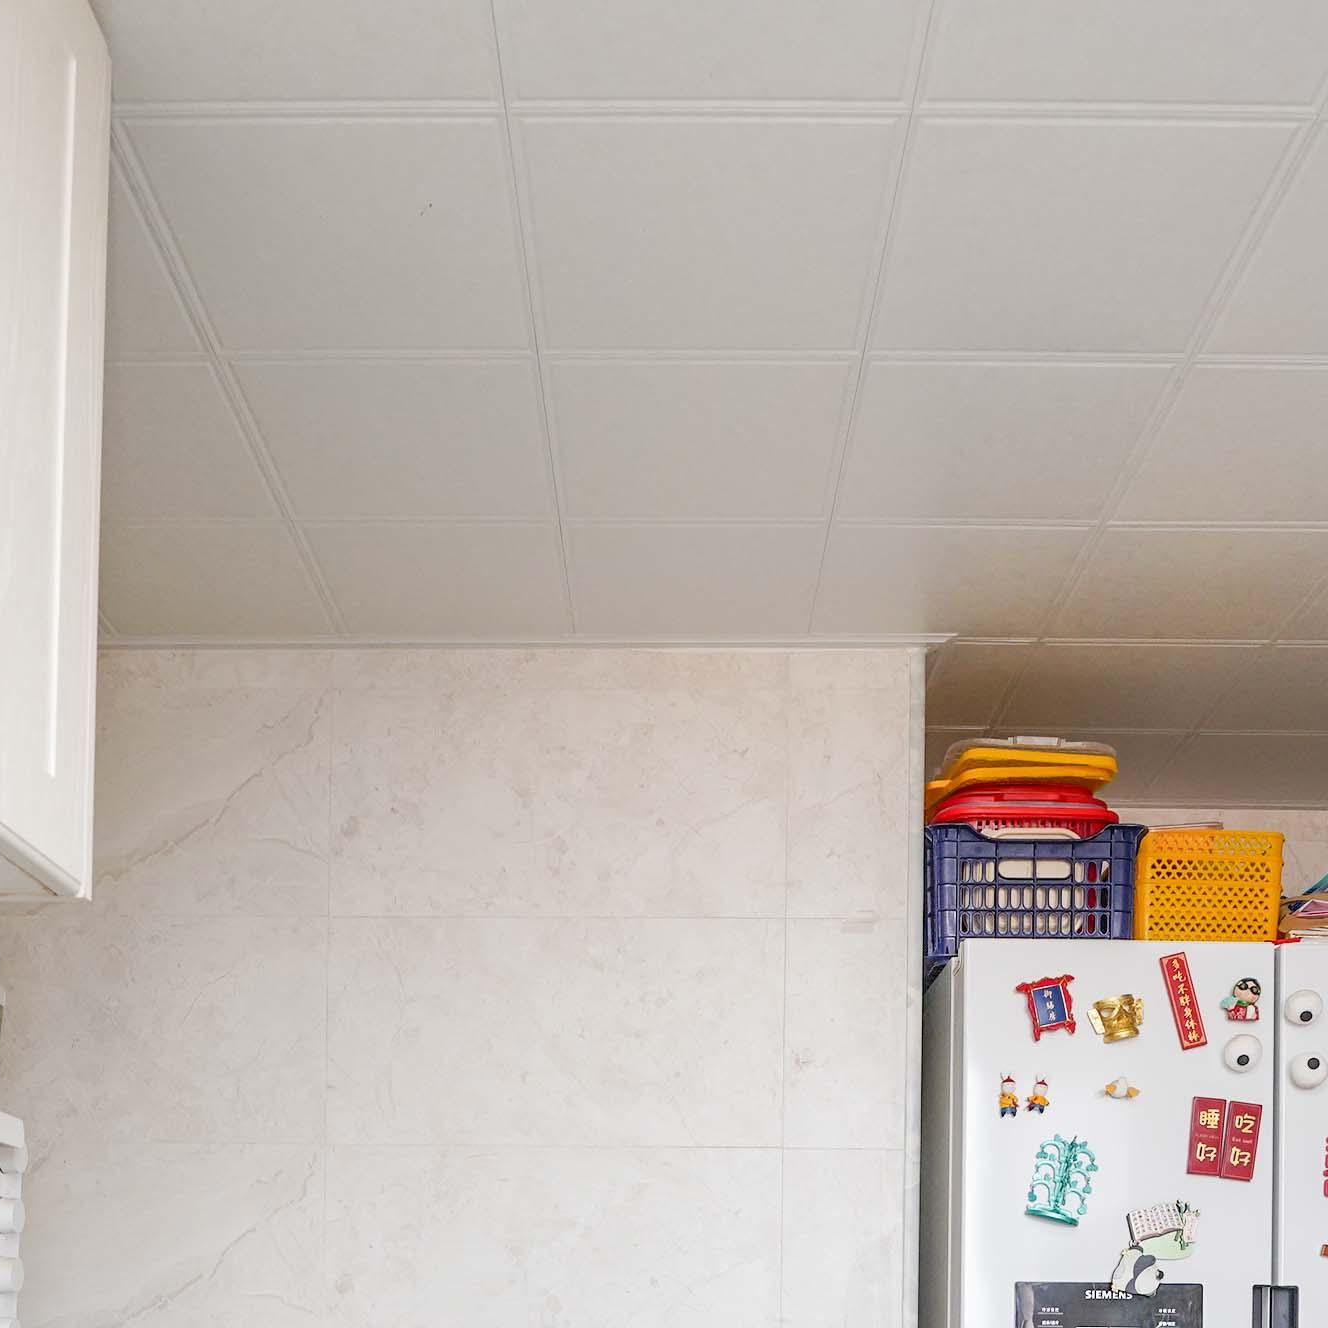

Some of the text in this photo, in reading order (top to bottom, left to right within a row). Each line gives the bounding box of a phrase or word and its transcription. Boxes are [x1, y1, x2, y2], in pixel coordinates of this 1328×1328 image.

[1172, 958, 1201, 1042] 多吃不胖身体棒
[1085, 1290, 1133, 1300] SIEMENS
